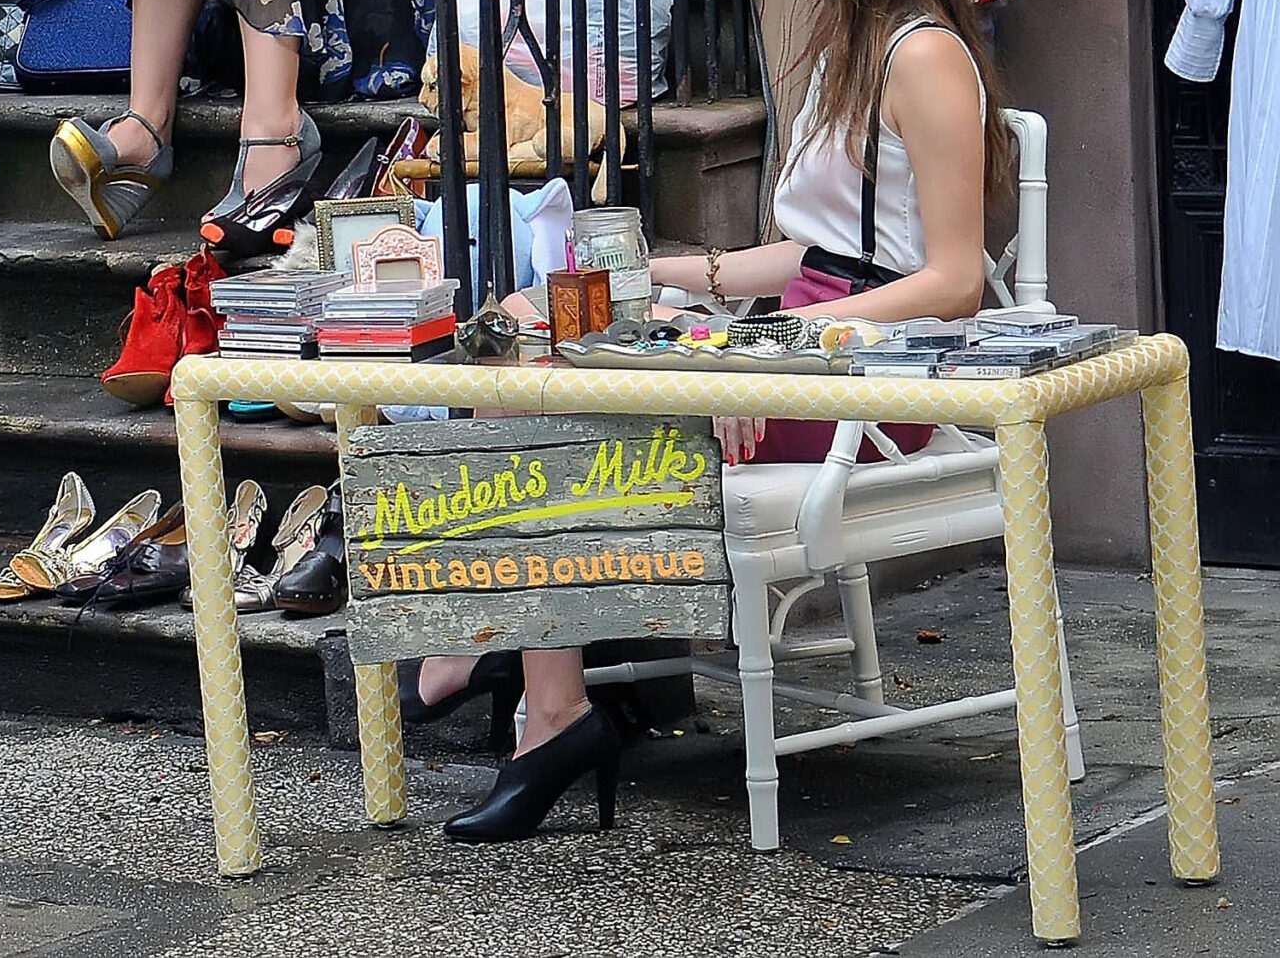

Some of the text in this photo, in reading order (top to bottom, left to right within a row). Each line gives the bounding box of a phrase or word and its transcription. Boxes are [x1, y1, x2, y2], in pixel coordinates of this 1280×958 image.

[358, 428, 706, 550] Maiden's Milk
[527, 549, 705, 587] Boutique
